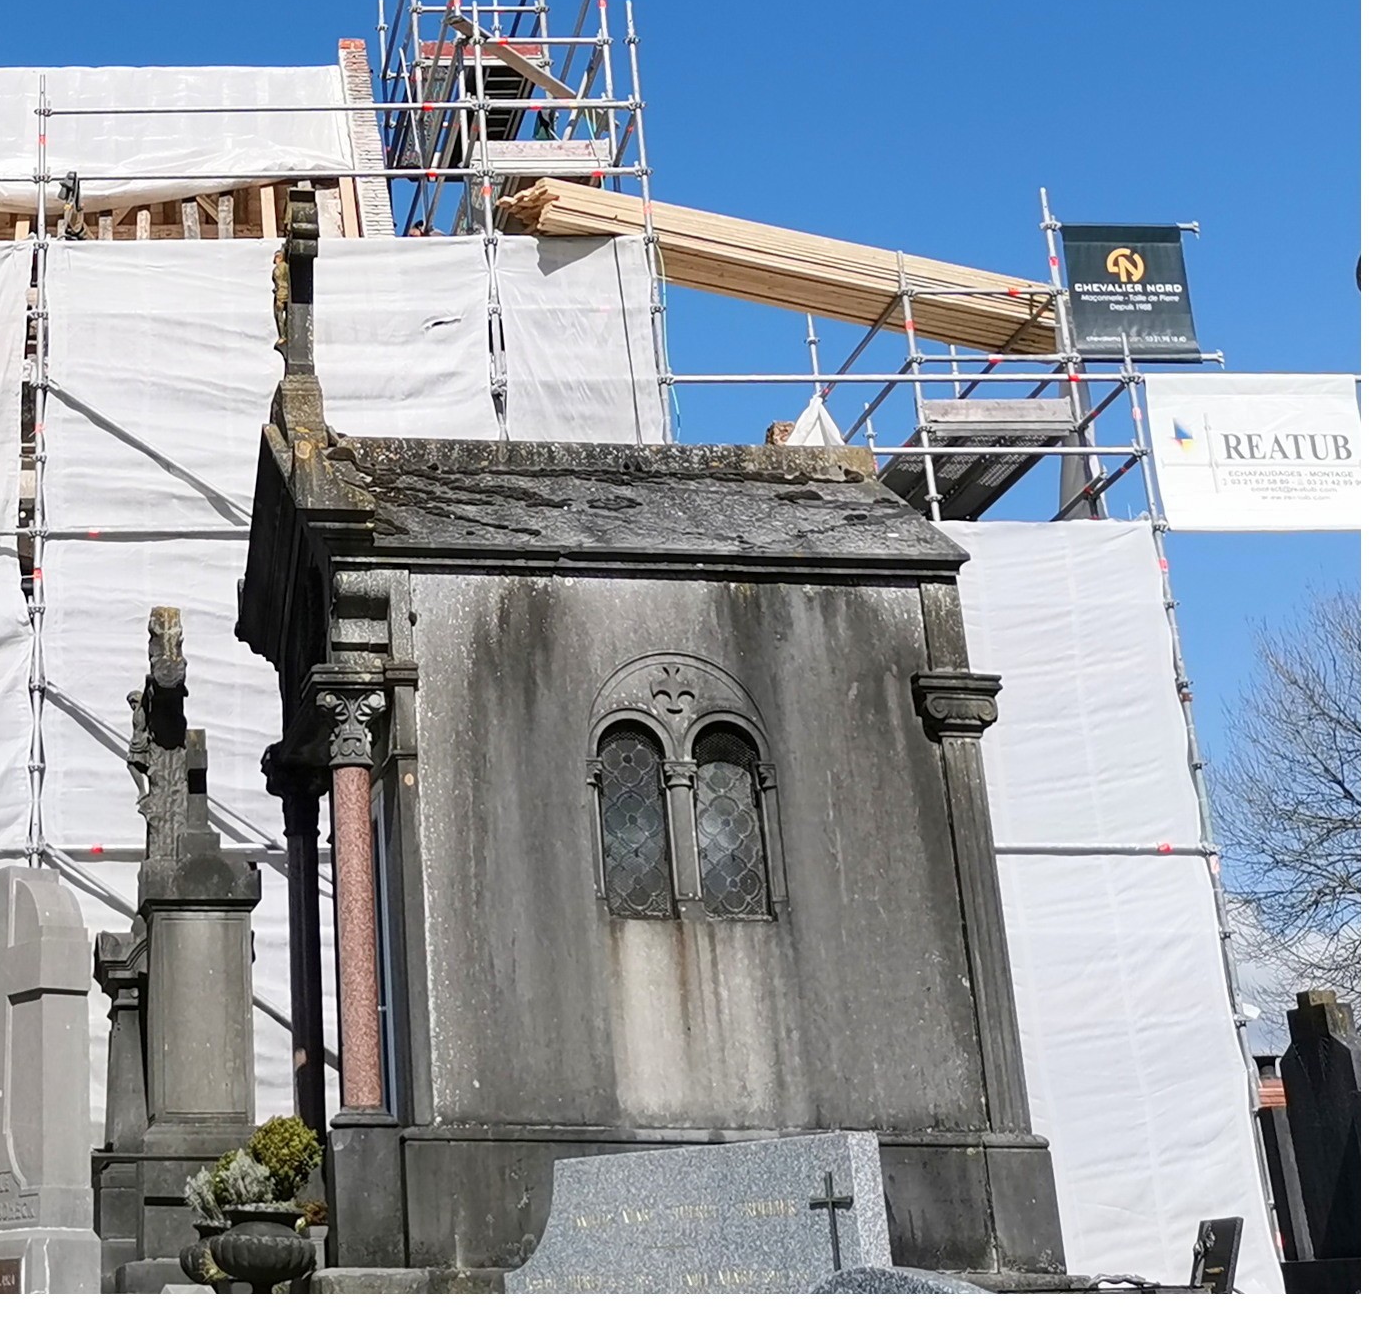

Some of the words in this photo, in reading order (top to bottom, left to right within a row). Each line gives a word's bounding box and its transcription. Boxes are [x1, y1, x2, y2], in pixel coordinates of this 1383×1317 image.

[1074, 283, 1143, 293] CHEVALIER
[1147, 284, 1183, 293] NORD
[1081, 294, 1124, 303] Maçonnerie
[1129, 294, 1147, 302] Taille
[1109, 303, 1135, 312] Depuis
[1220, 433, 1353, 461] REATUB
[1228, 470, 1303, 478] ECHAFAUDAGES
[1309, 470, 1354, 479] MONTAGE
